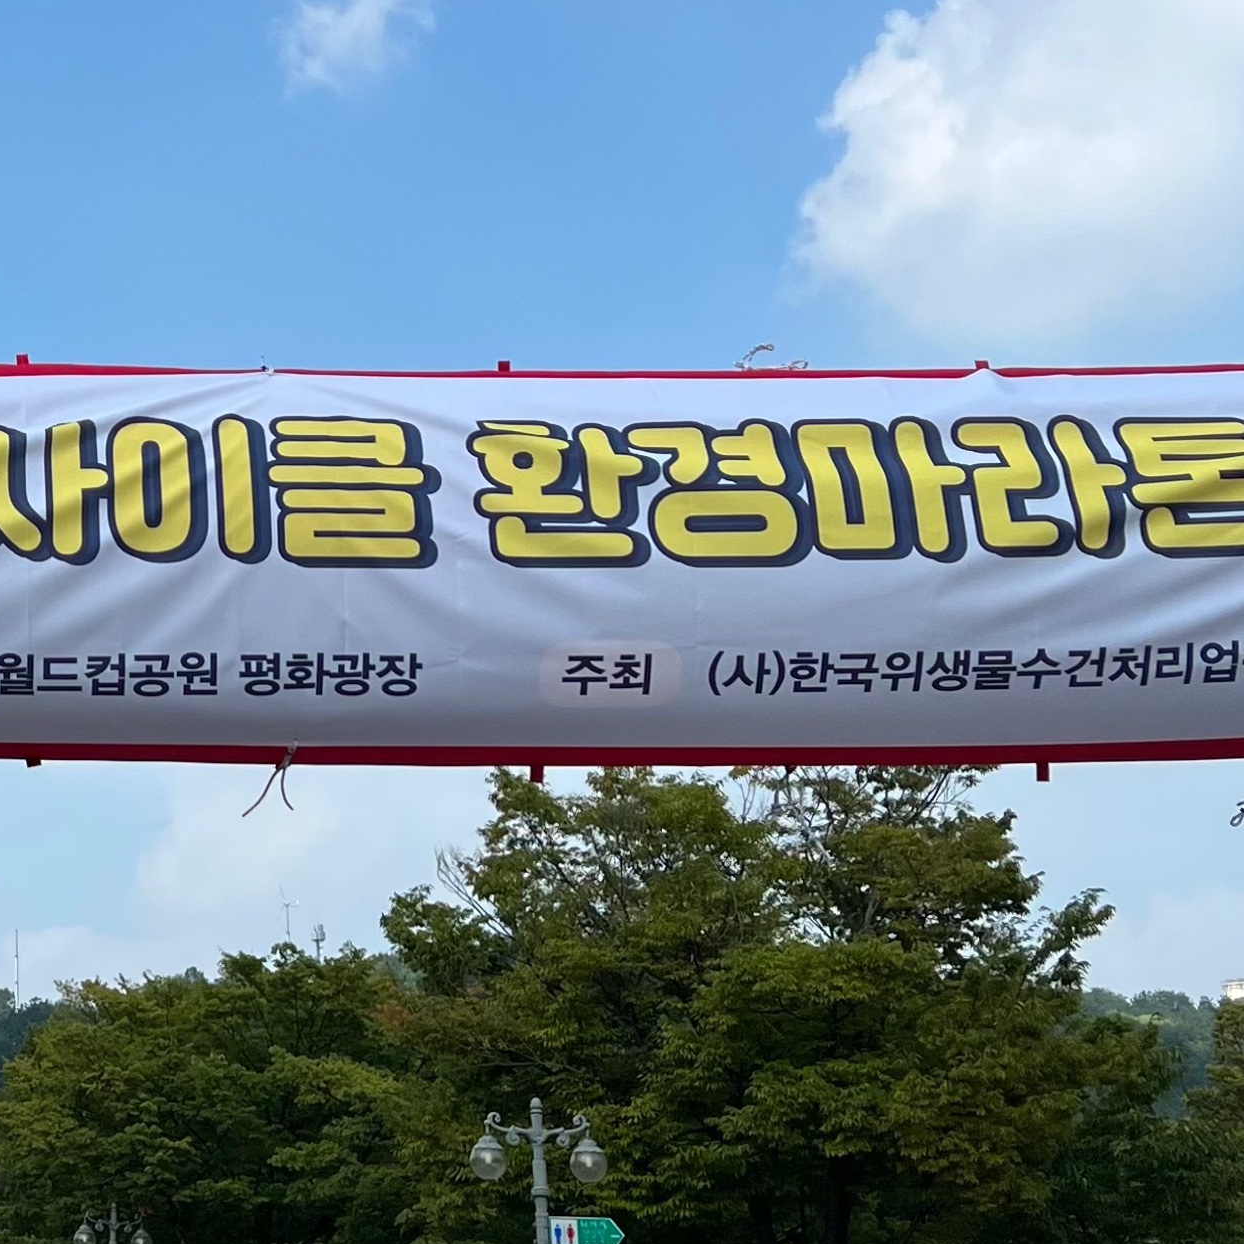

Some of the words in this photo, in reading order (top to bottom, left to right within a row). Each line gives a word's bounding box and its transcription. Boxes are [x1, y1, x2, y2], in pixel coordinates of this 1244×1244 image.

[466, 415, 1244, 568] 환경마라톤
[239, 653, 423, 696] 평화광장
[562, 654, 652, 695] 주최
[709, 641, 1244, 696] (사)한국위생물수건처리업
